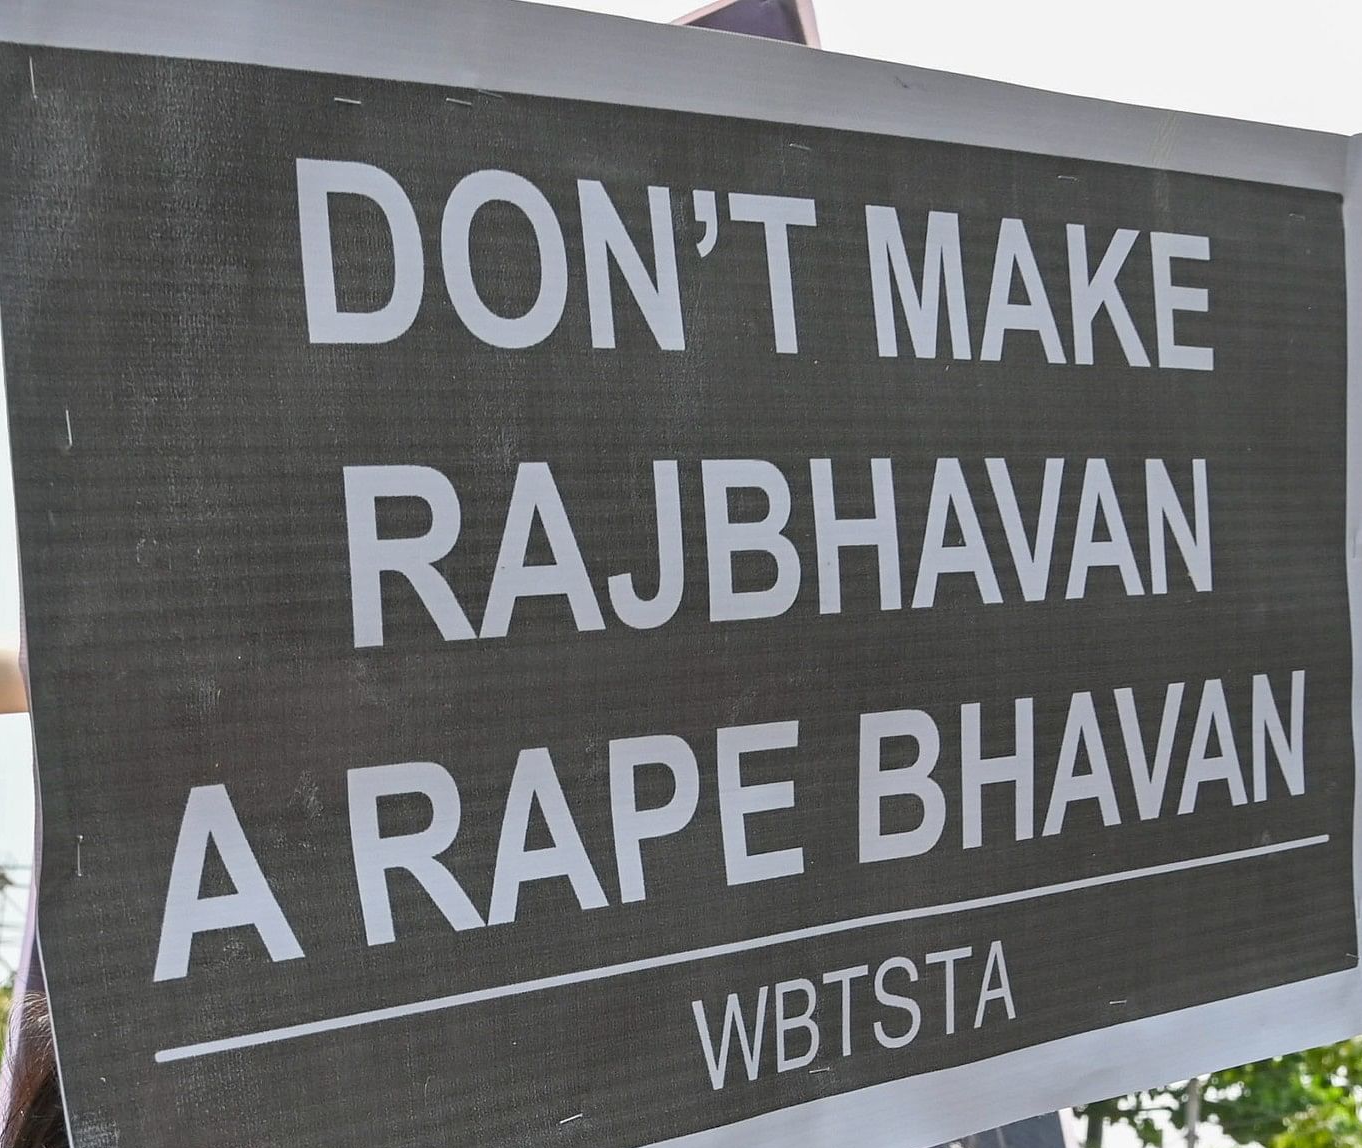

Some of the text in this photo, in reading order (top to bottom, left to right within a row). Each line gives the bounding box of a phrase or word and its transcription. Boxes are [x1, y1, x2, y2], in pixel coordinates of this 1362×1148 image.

[865, 204, 1214, 372] MAKE
[343, 457, 1213, 648] RAJBHAVAN
[153, 669, 1306, 983] A RAPE BHAVAN
[691, 940, 1018, 1091] WBTSTA
